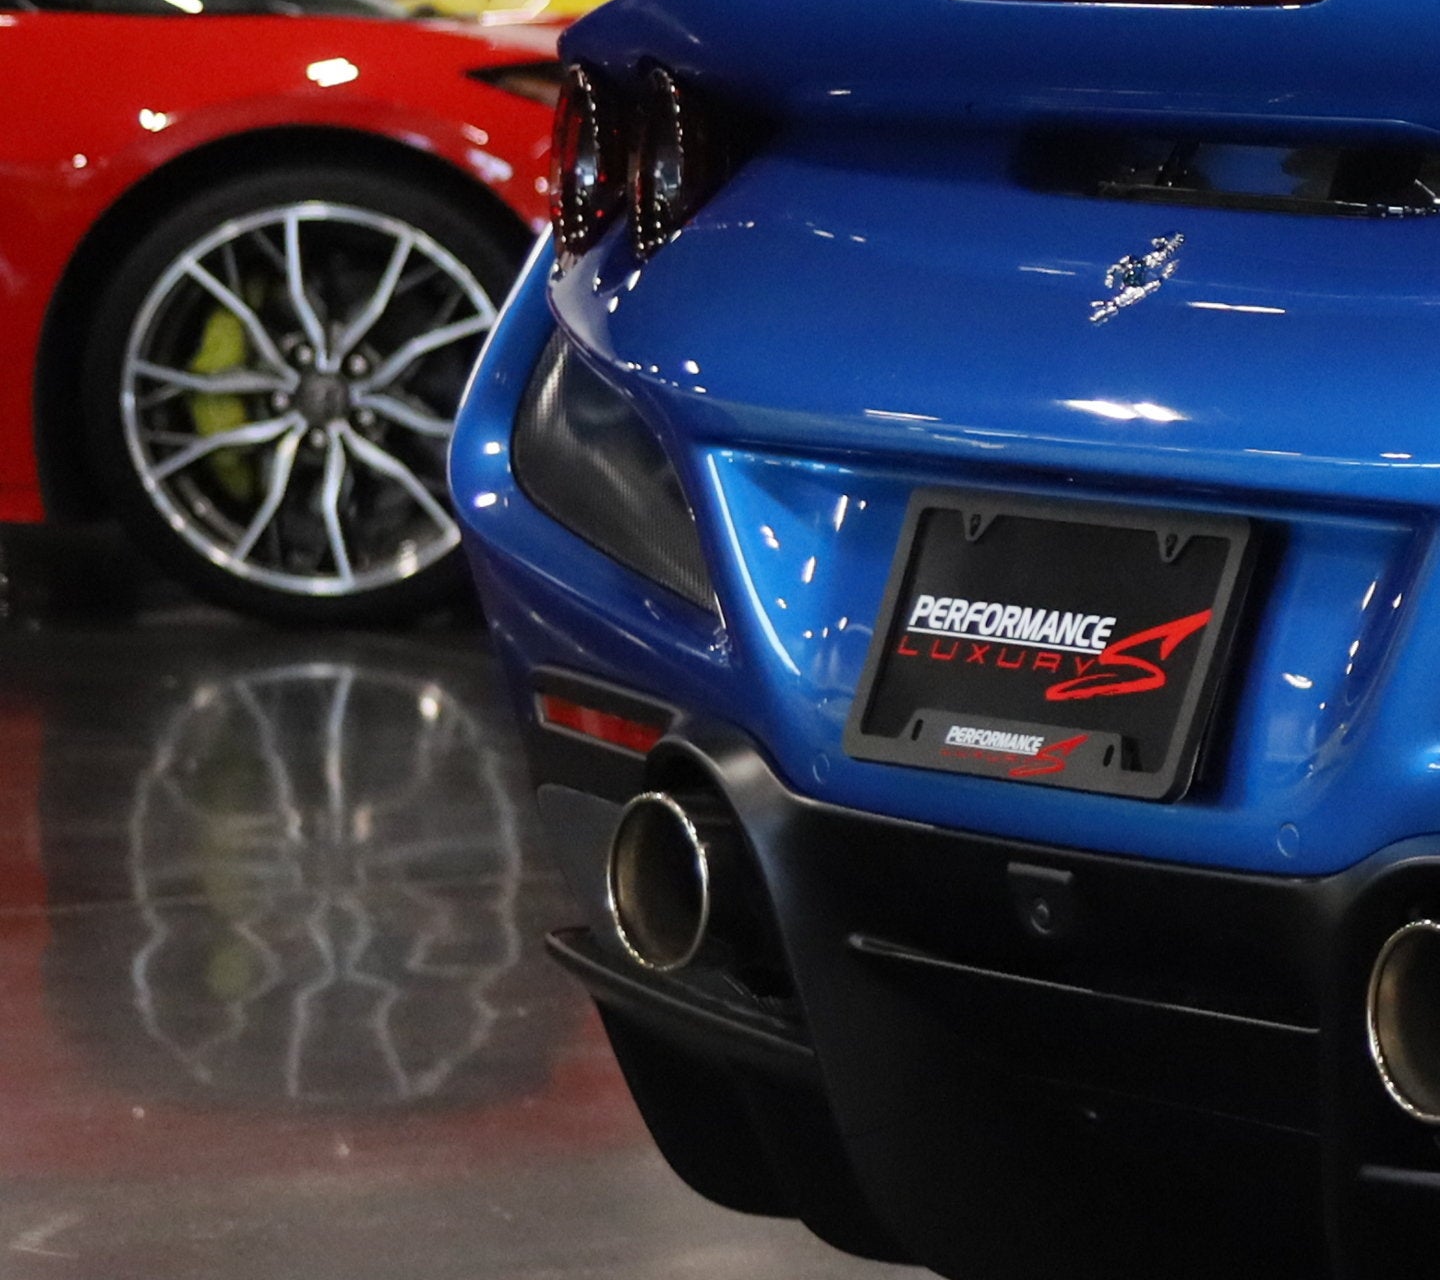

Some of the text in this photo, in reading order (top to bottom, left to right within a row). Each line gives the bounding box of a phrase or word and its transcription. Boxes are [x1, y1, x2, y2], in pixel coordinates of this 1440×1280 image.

[908, 595, 1117, 650] PERFORMANCE
[898, 635, 1099, 676] LUXURY
[945, 726, 1045, 753] PERFORMANCE
